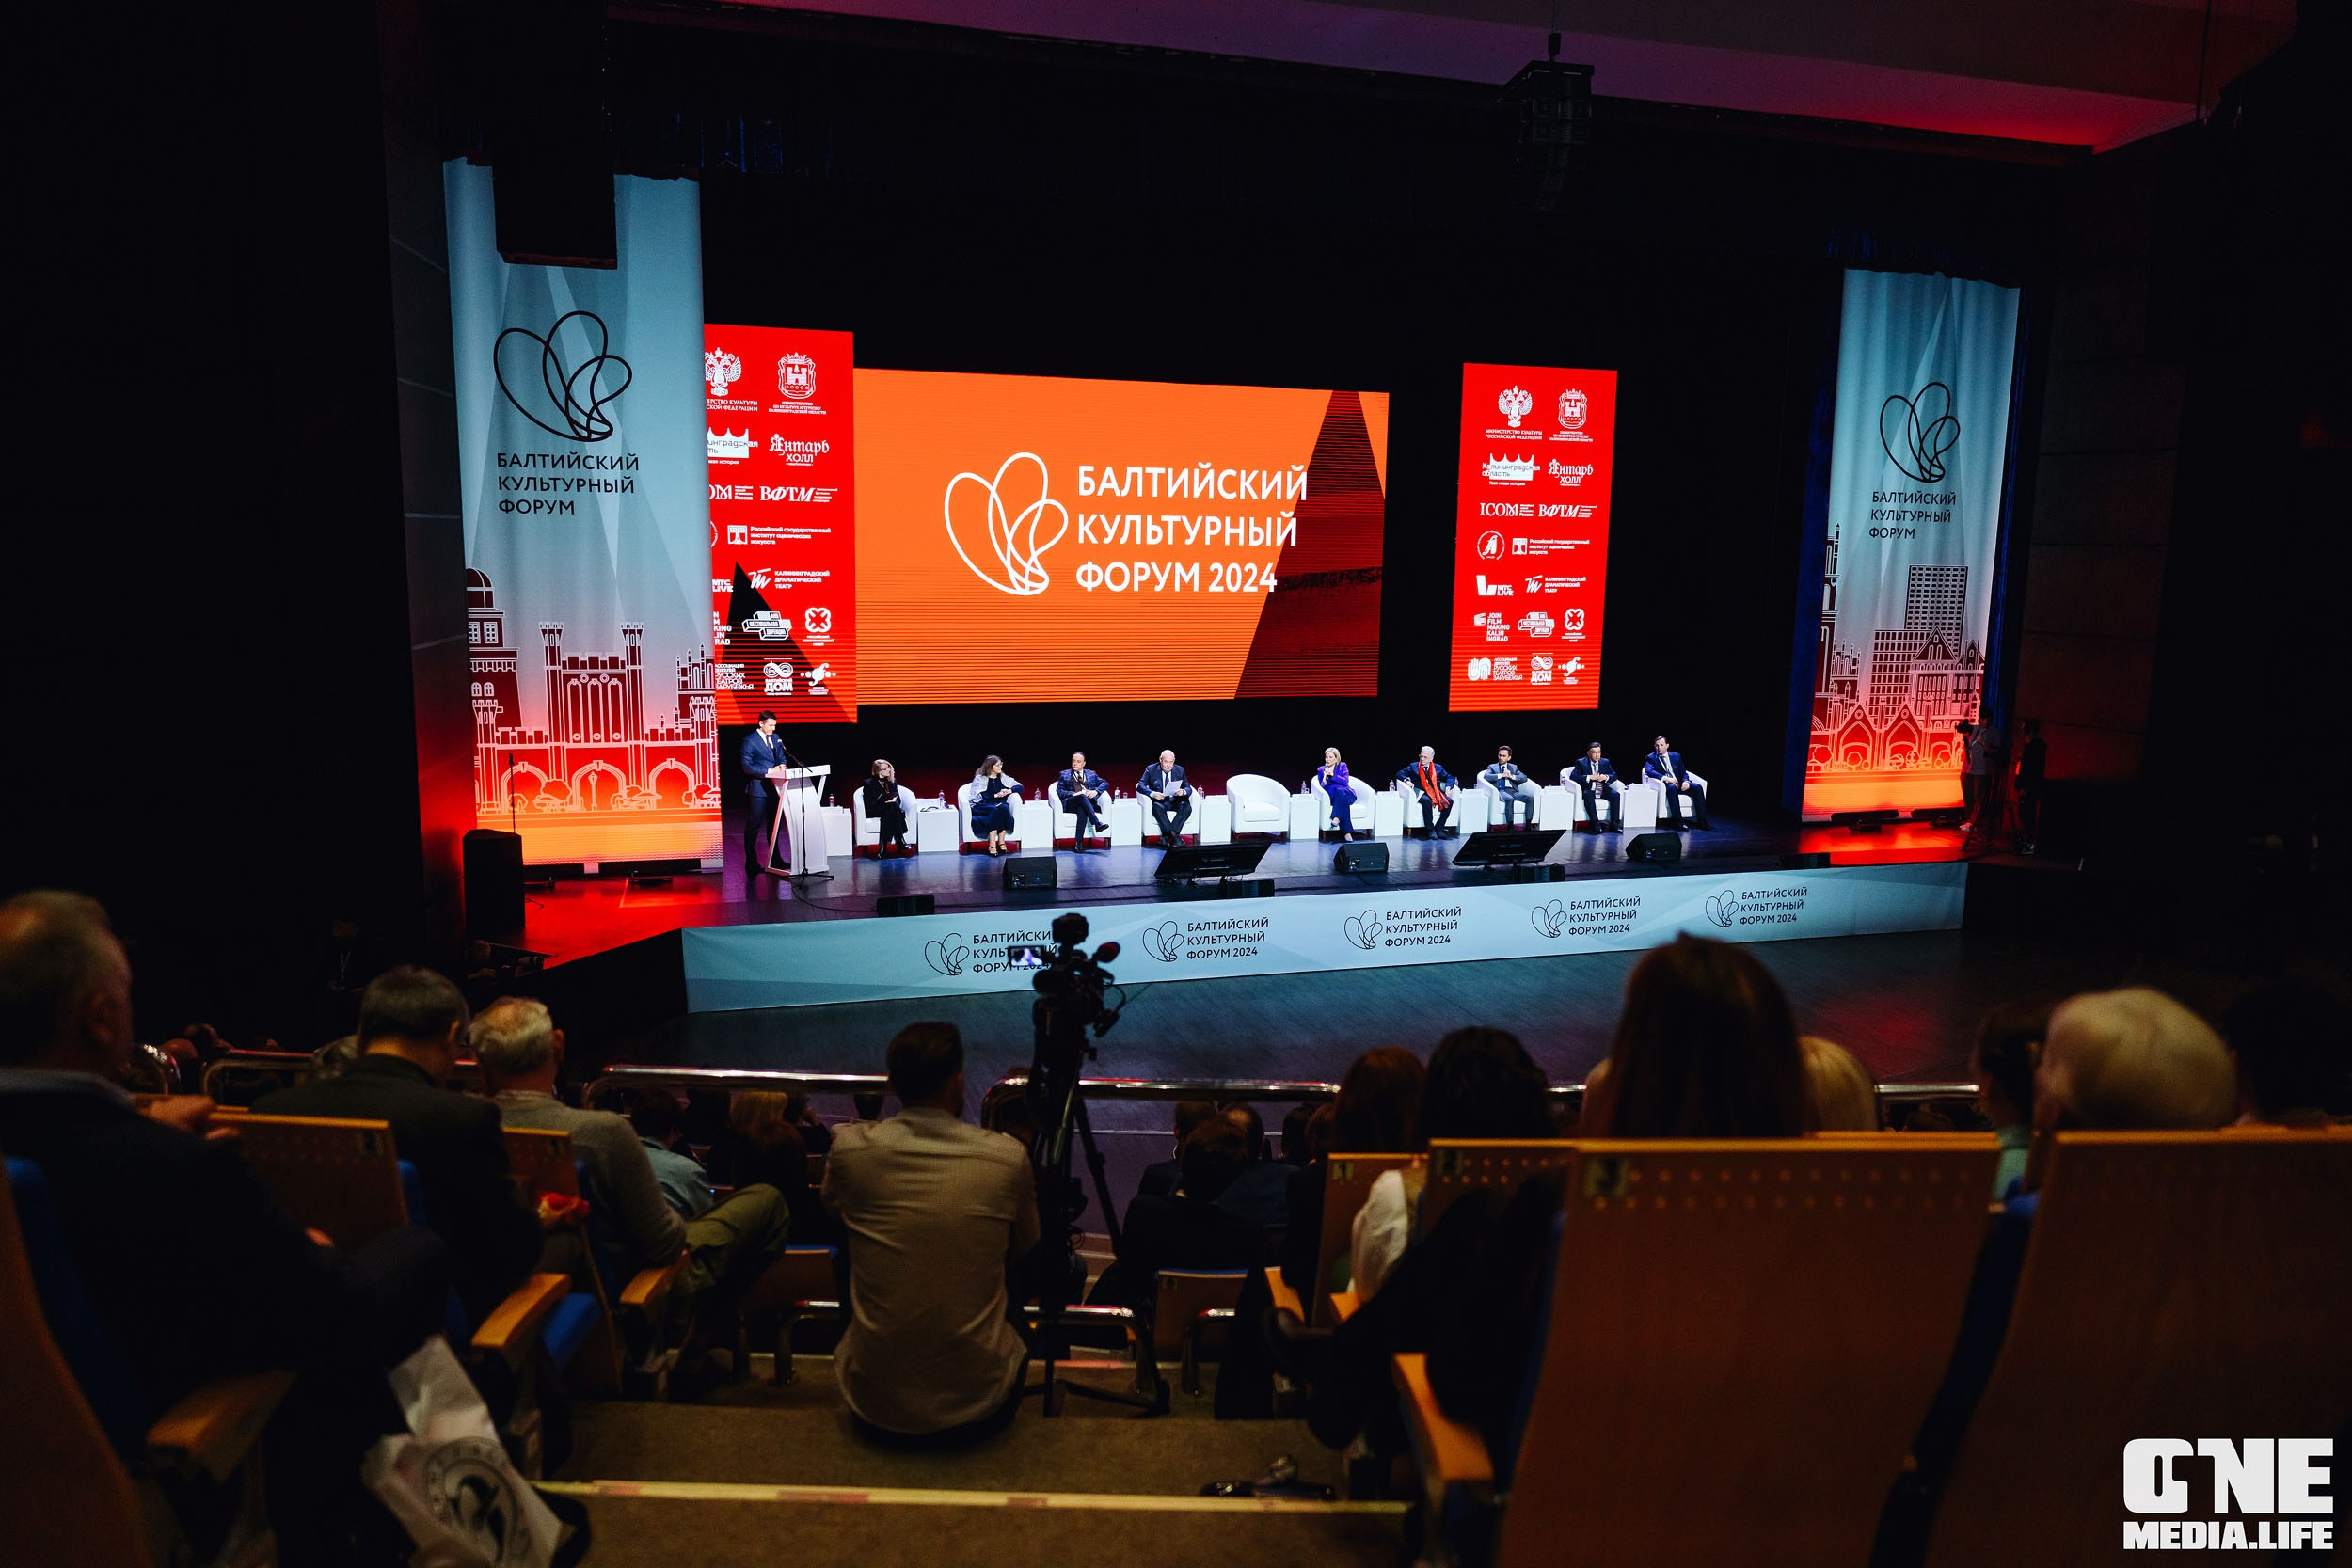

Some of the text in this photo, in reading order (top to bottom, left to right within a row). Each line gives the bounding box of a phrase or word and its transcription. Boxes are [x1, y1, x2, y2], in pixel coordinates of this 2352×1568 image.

[497, 451, 639, 470] БАЛТИЙСКИЙ
[786, 453, 813, 463] ХОЛЛ
[498, 476, 634, 494] КУЛЬТУРНЫЙ
[1078, 461, 1308, 501] БАЛТИЙСКИЙ
[759, 485, 816, 502] ВФТМ
[1872, 491, 1957, 505] БАЛТИЙСКИЙ
[499, 499, 575, 515] ФОРУМ
[1479, 502, 1518, 517] ICOM
[1538, 504, 1581, 518] ВФТМ
[1870, 509, 1951, 523] КУЛЬТУРНЫЙ
[1078, 511, 1297, 546] КУЛЬТУРНЫЙ
[1868, 527, 1915, 539] ФОРУМ
[1075, 562, 1278, 593] ФОРУМ 2024
[1741, 886, 1807, 900] БАЛТИЙСКИЙ
[1570, 895, 1641, 911] БАЛТИЙСКИЙ
[1740, 899, 1804, 912] КУЛЬТУРНЫЙ
[1386, 905, 1462, 921] БАЛТИЙСКИЙ
[1568, 909, 1637, 924] КУЛЬТУРНЫЙ
[1740, 913, 1797, 926] ФОРУМ 2024
[1187, 916, 1269, 932] БАЛТИЙСКИЙ
[1385, 919, 1458, 934] КУЛЬТУРНЫЙ
[1568, 924, 1630, 936] ФОРУМ 2024
[973, 929, 1051, 944] БАЛТИЙСКИ
[1186, 930, 1265, 946] КУЛЬТУРНЫЙ
[1384, 934, 1451, 947] ФОРУМ 2024
[1186, 946, 1258, 961] ФОРУМ 2024
